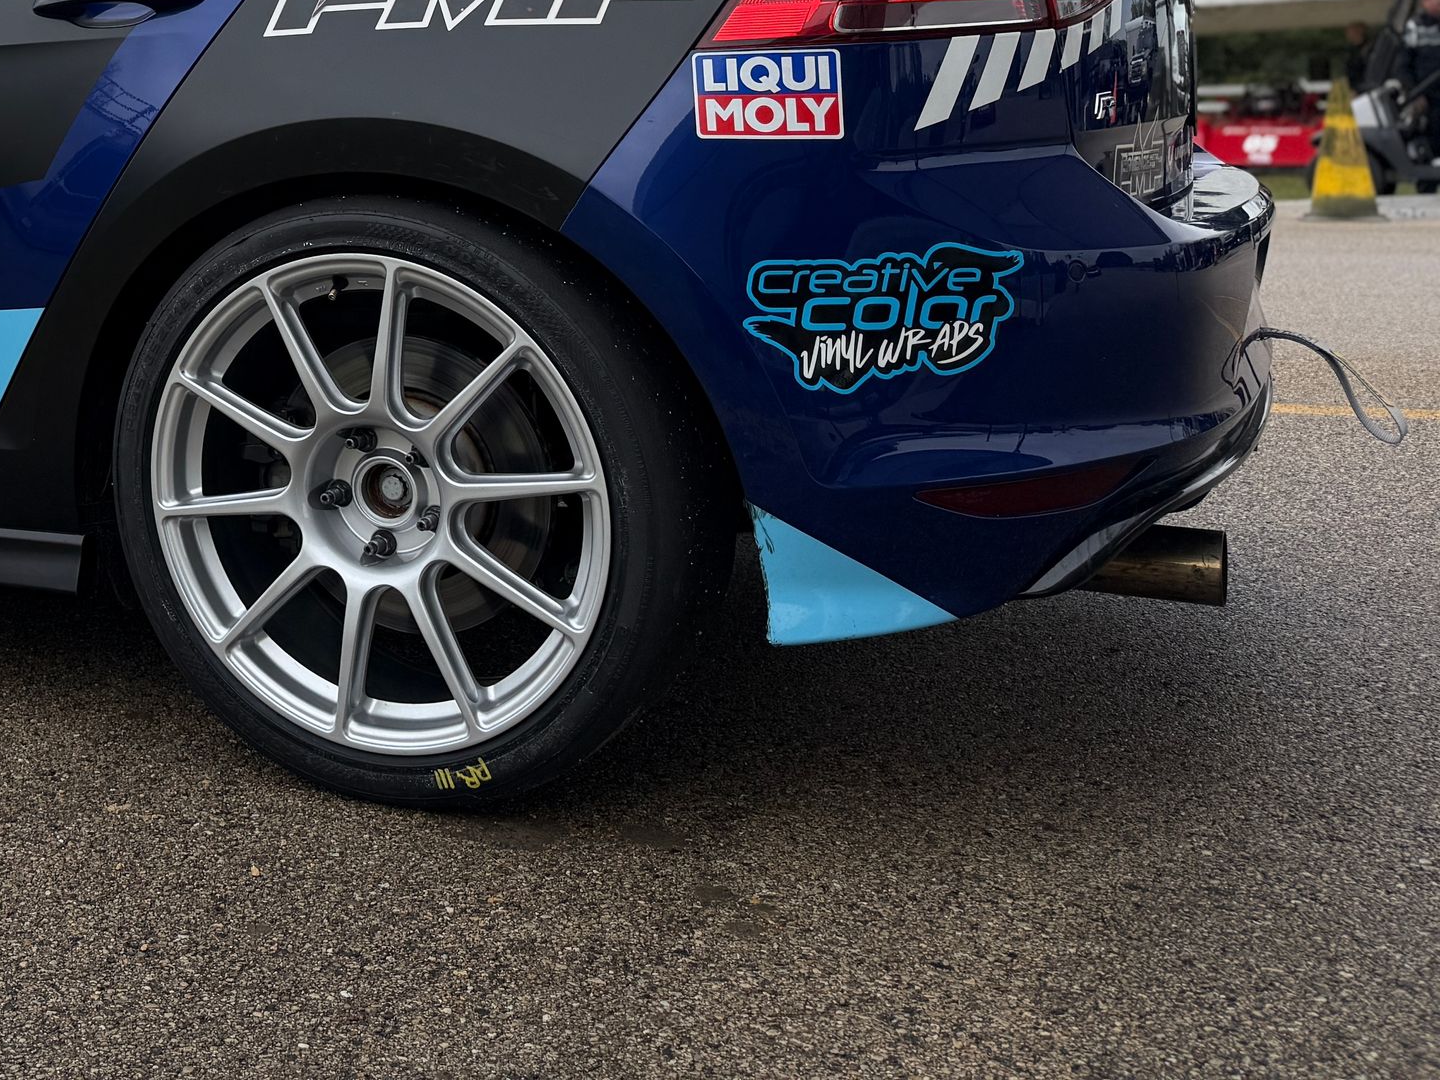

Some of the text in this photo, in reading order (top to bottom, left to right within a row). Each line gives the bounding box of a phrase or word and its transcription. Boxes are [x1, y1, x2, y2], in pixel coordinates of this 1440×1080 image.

[702, 55, 830, 94] LIQUI
[705, 97, 836, 133] MOLY
[758, 262, 982, 294] creative
[801, 286, 997, 331] color
[877, 320, 984, 367] WRAPS
